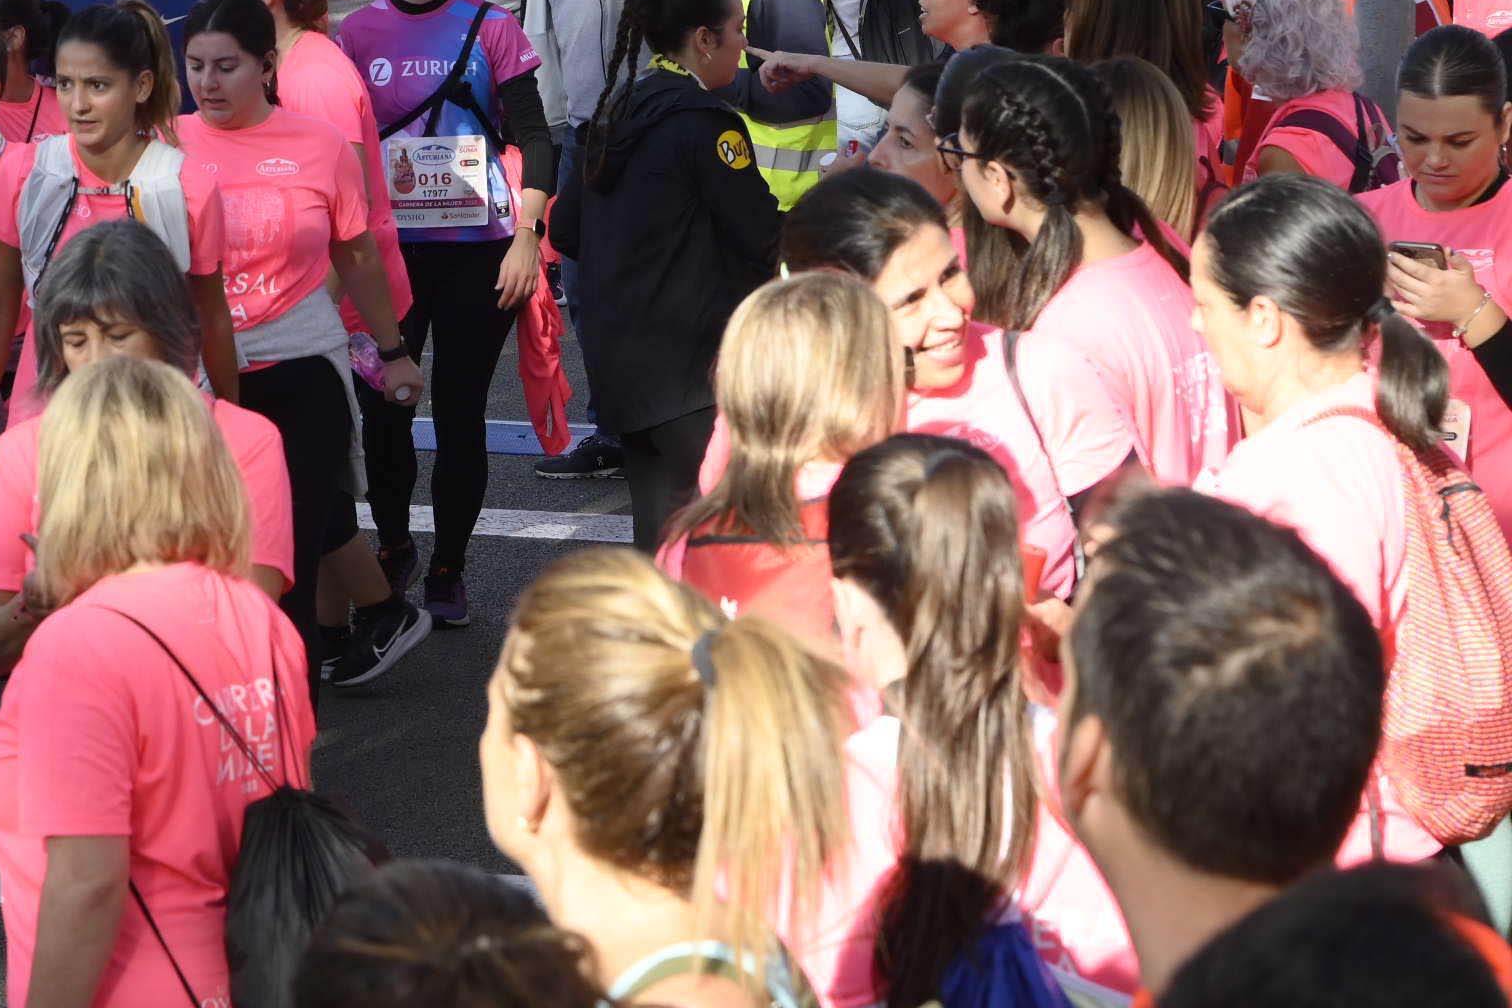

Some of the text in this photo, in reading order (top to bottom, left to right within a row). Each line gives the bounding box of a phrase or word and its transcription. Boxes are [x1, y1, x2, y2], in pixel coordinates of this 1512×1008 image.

[416, 152, 453, 161] ASTURIANA
[418, 172, 452, 186] 016
[423, 189, 449, 198] 17977
